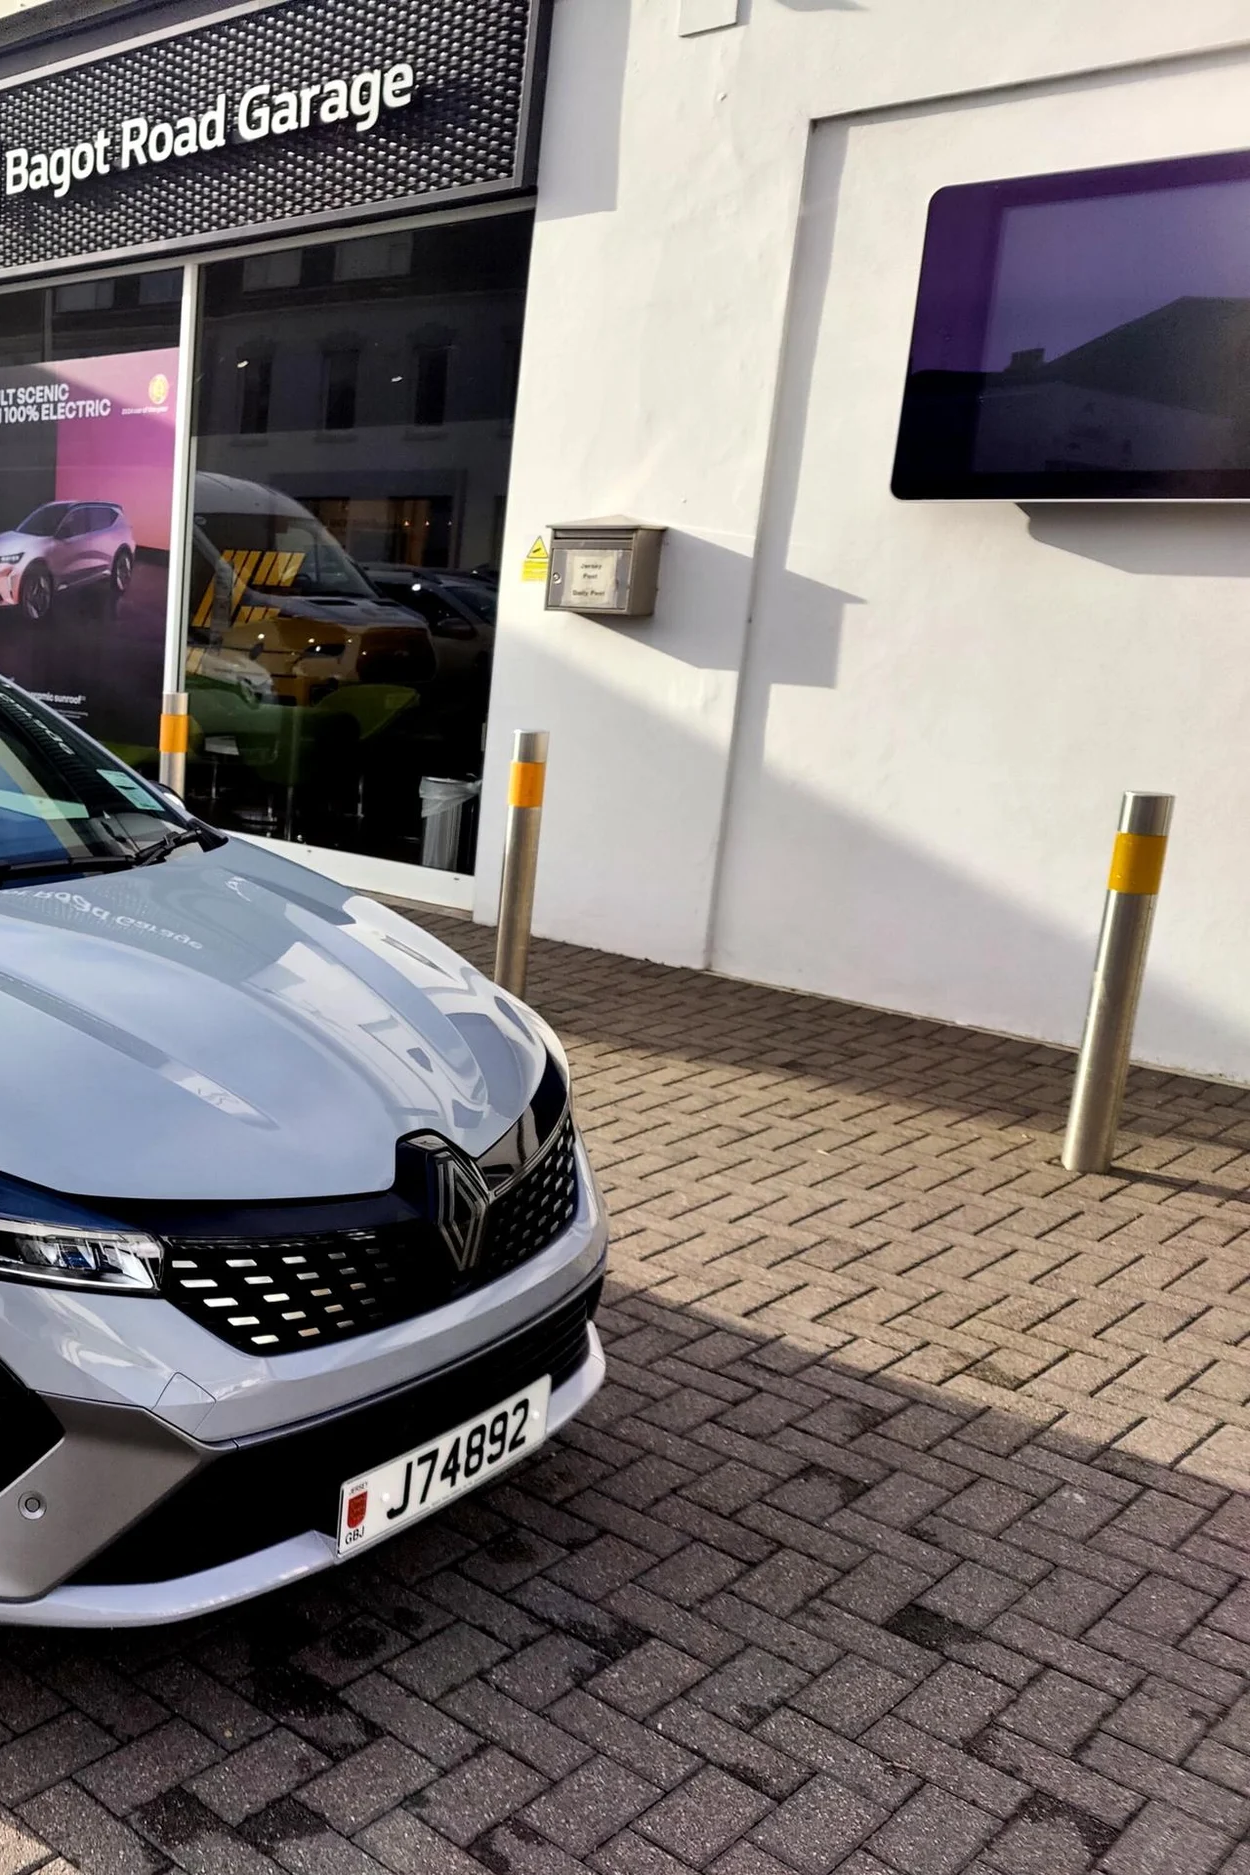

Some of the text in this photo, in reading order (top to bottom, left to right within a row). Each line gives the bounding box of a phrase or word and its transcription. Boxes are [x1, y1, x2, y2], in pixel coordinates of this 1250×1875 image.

[5, 62, 414, 198] Bagot Road Garage
[16, 383, 70, 405] SCENIC
[3, 405, 40, 423] 100%
[41, 399, 111, 421] ELECTRIC
[386, 1398, 530, 1520] J74892
[344, 1525, 365, 1545] GBJ
